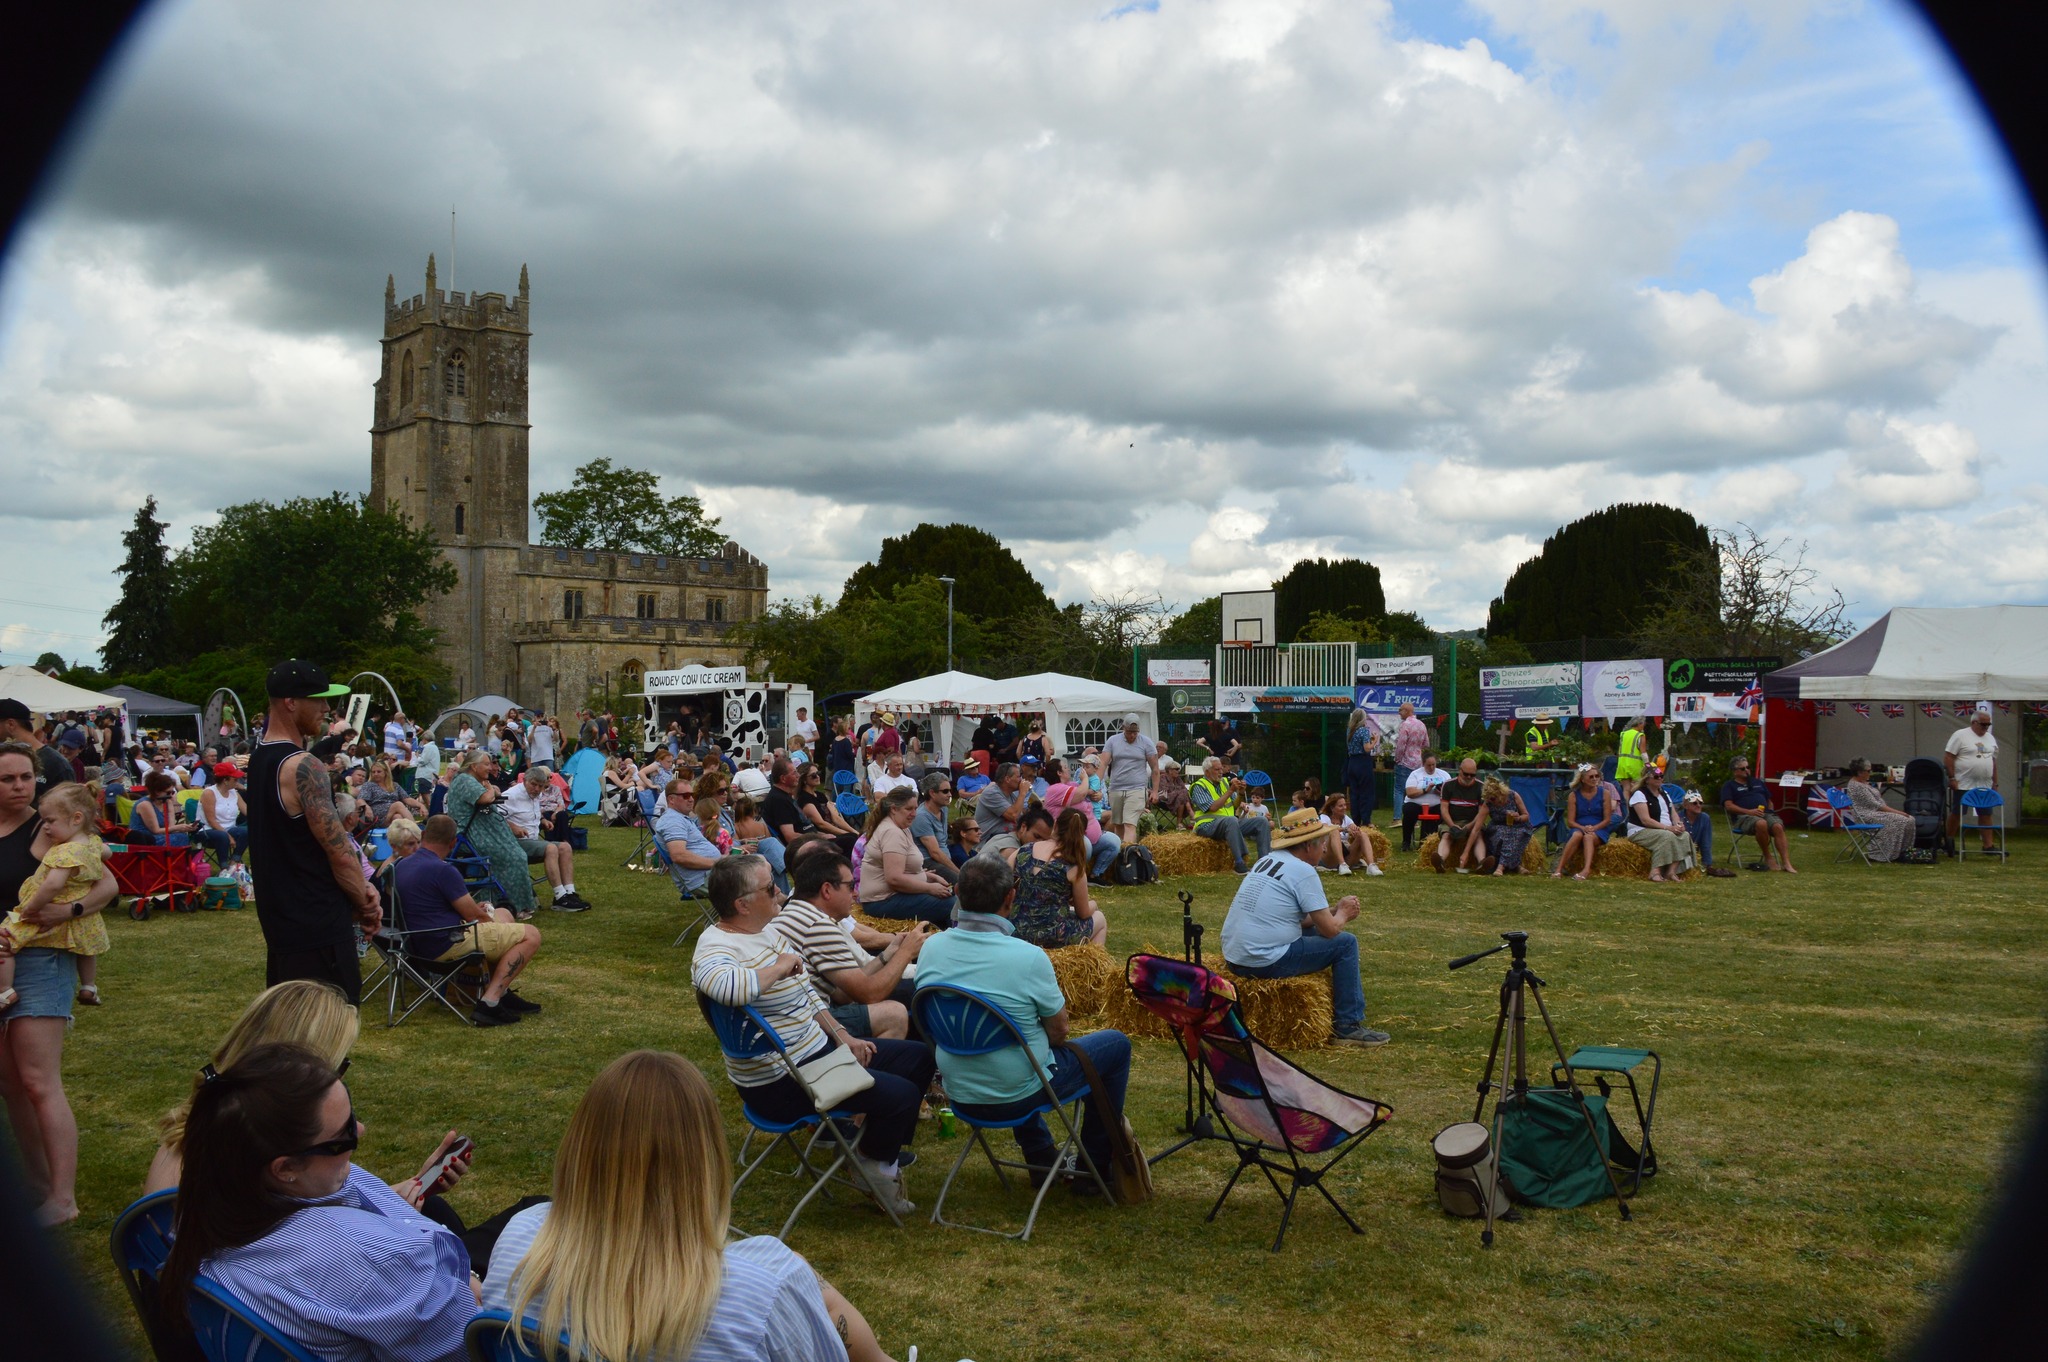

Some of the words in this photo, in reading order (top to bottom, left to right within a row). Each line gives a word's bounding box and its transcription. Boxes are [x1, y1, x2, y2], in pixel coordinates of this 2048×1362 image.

[650, 676, 680, 686] ROWDEY
[682, 674, 698, 685] COW
[700, 674, 712, 684] ICE
[714, 672, 741, 683] CREAM
[1502, 677, 1554, 686] Chiropractice
[1384, 690, 1420, 704] FRUCI
